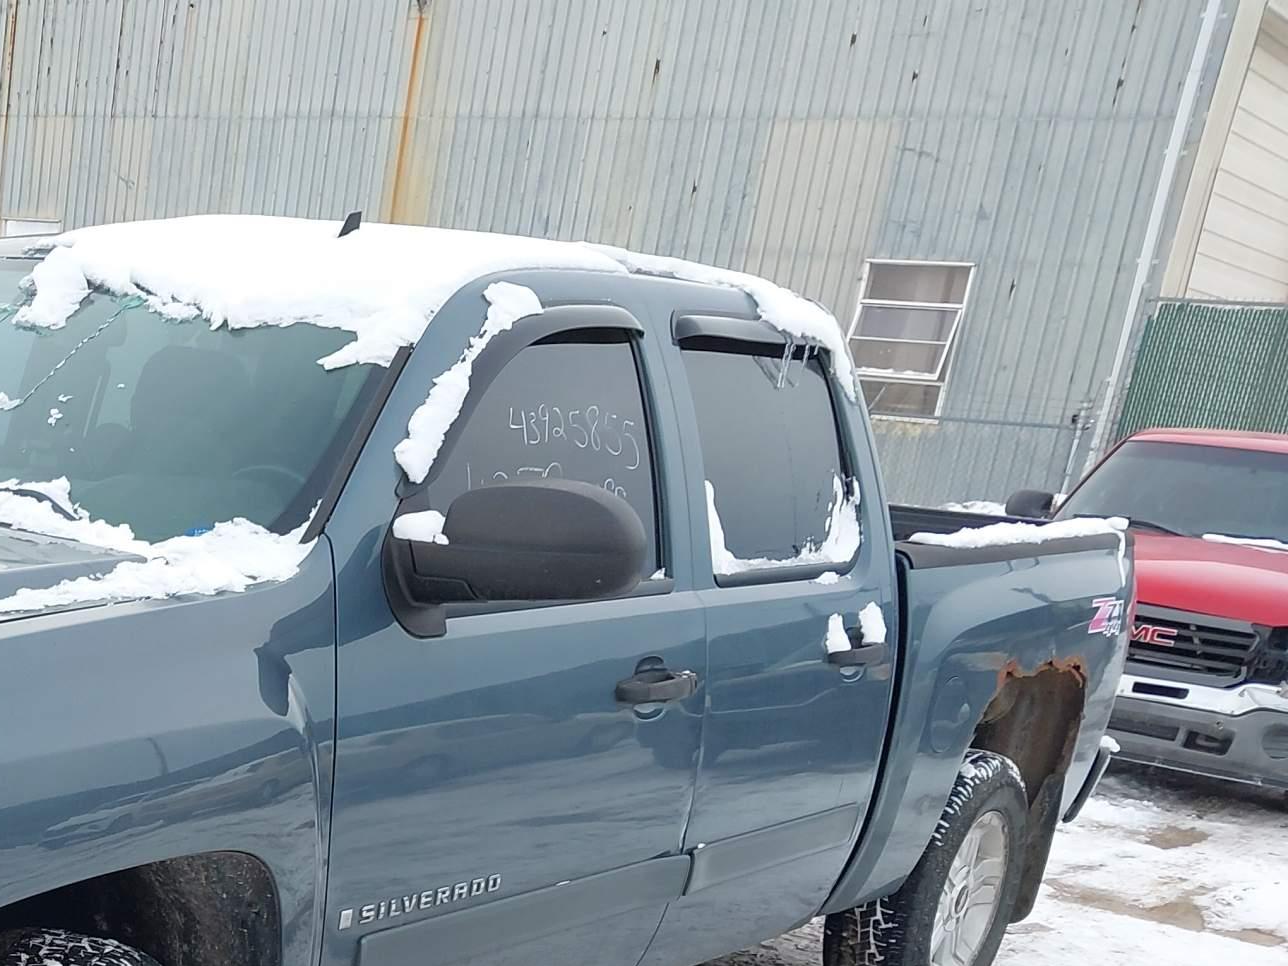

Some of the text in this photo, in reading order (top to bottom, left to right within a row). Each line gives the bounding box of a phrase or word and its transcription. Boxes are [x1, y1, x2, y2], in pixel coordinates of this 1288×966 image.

[509, 404, 640, 470] 43925855
[1131, 624, 1178, 647] MC
[359, 873, 502, 924] SILVERADO
